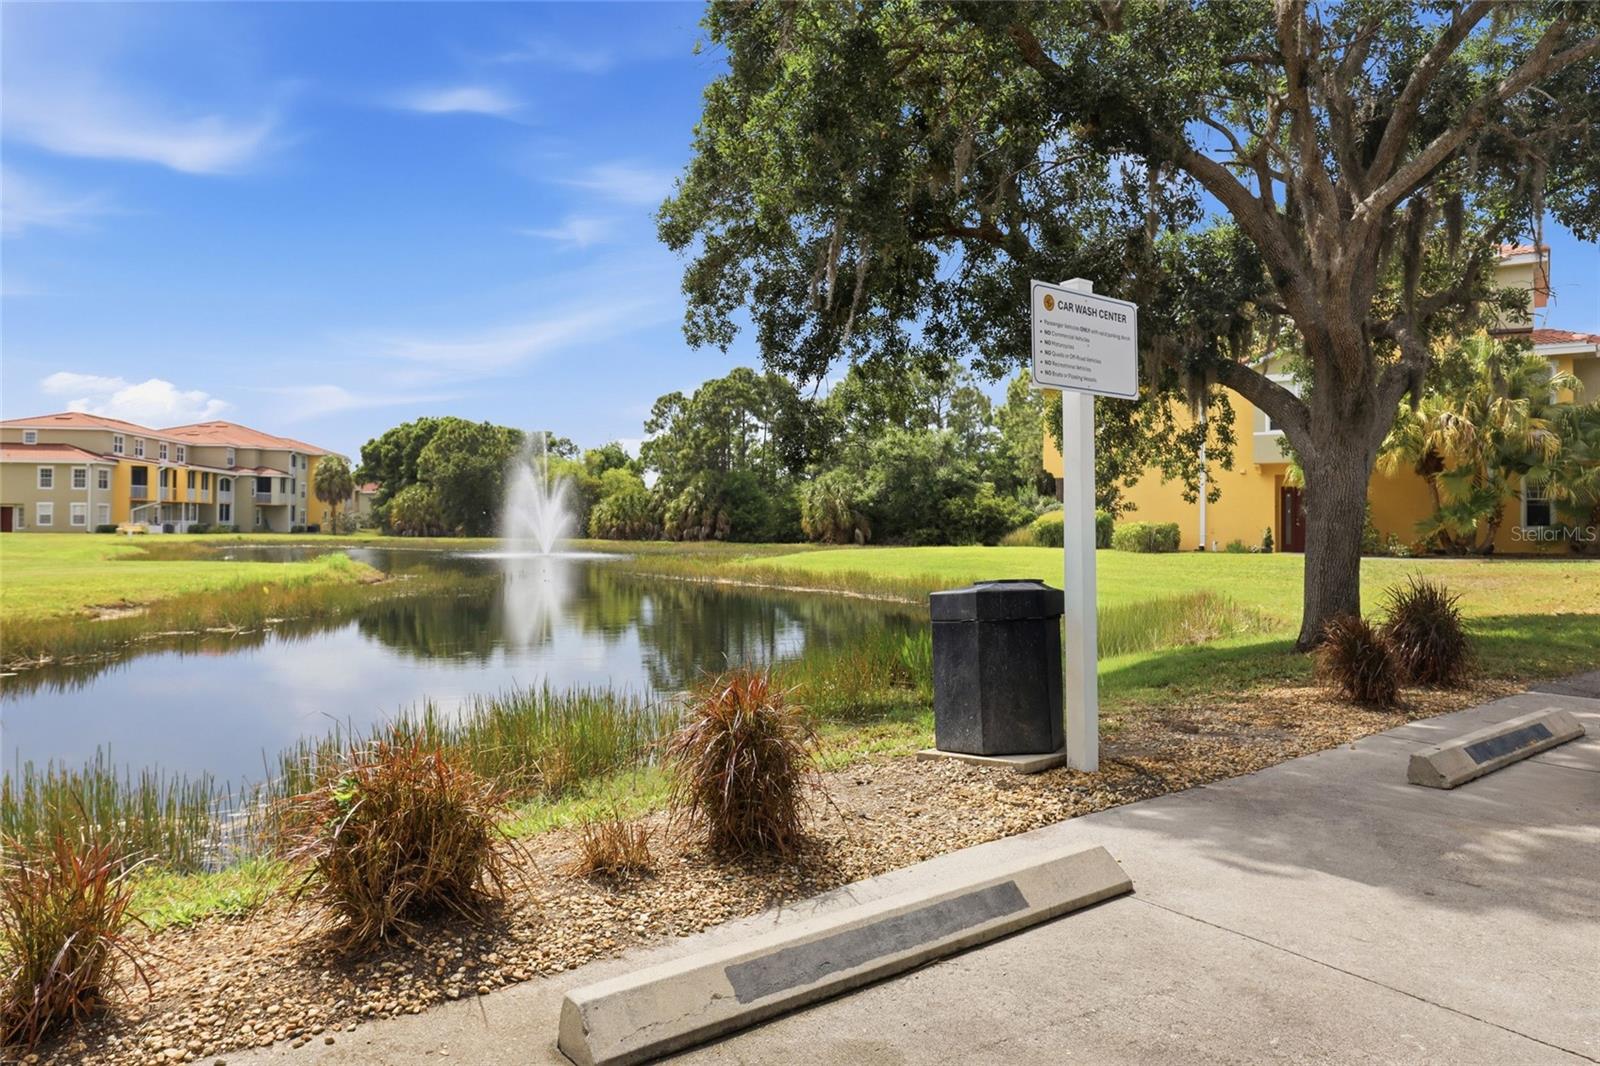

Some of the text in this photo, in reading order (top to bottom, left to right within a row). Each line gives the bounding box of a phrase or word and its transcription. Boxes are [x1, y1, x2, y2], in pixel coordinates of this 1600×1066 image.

[1058, 301, 1127, 324] CAR WASH CENTER
